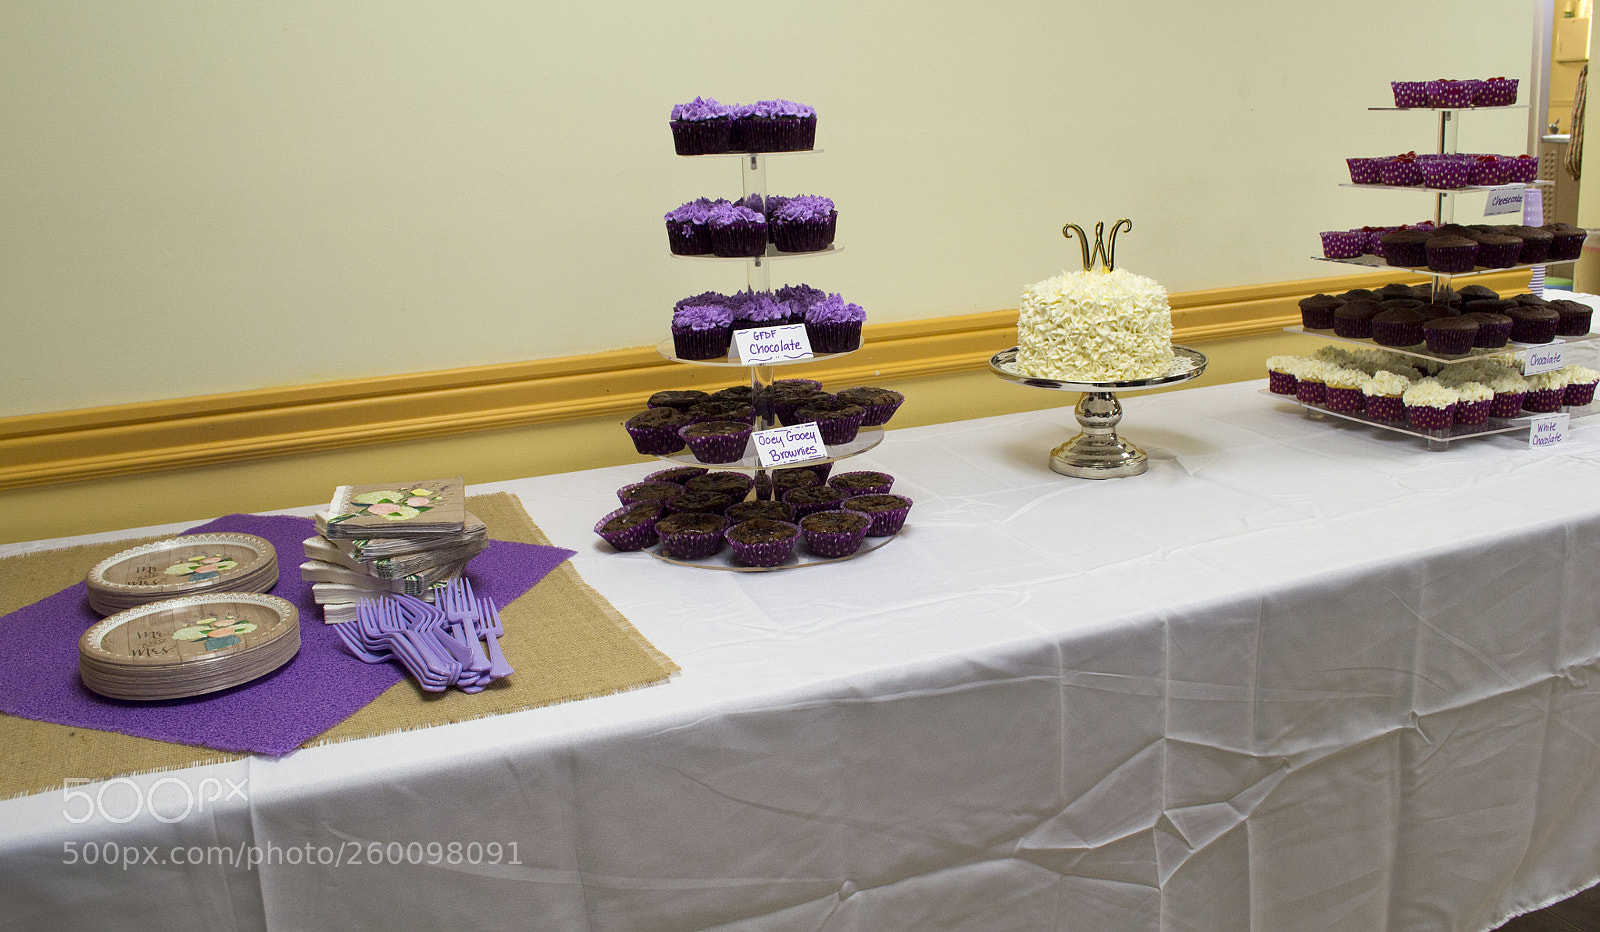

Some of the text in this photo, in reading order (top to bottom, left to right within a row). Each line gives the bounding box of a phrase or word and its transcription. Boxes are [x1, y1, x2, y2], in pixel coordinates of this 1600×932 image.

[1062, 218, 1132, 272] W
[753, 330, 777, 341] GFDF
[749, 339, 803, 355] Chocolate
[1530, 352, 1562, 366] Chocolate
[1537, 422, 1557, 433] White
[758, 430, 817, 448] Ooey Gooey
[1532, 432, 1562, 446] Chocolate
[769, 445, 818, 461] Brownies
